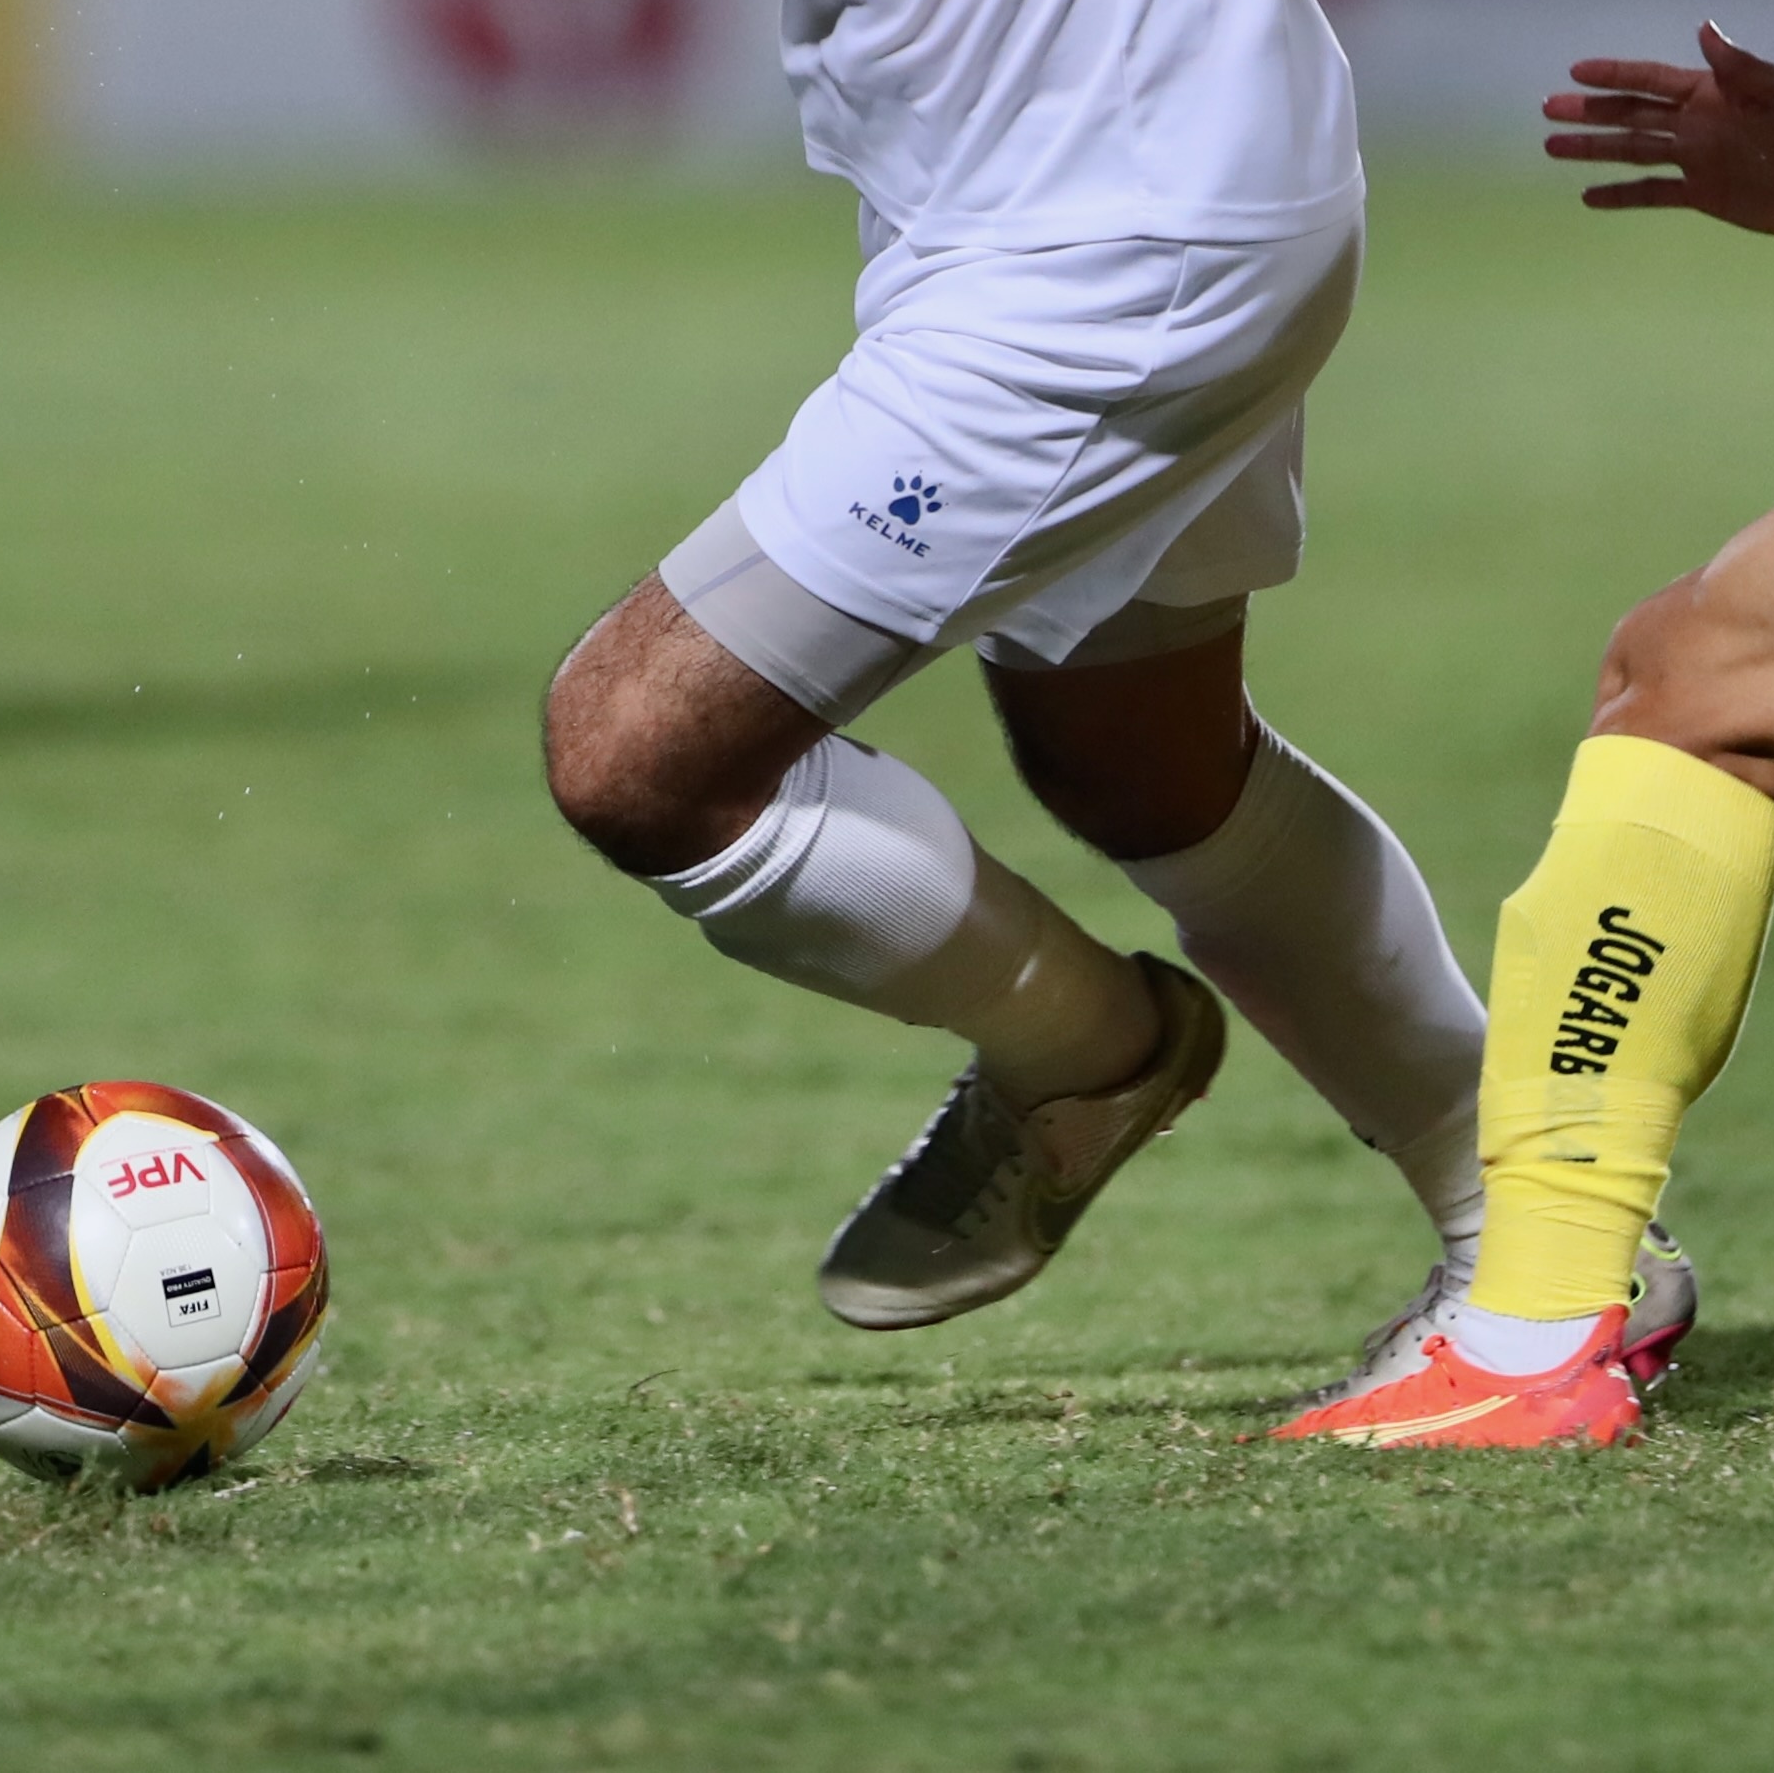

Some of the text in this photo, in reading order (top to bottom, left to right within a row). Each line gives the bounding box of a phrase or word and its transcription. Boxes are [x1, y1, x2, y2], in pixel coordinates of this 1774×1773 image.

[848, 501, 932, 559] KELME
[1550, 905, 1666, 1075] JOGARB
[107, 1152, 206, 1199] VPF
[167, 1283, 183, 1293] PRO
